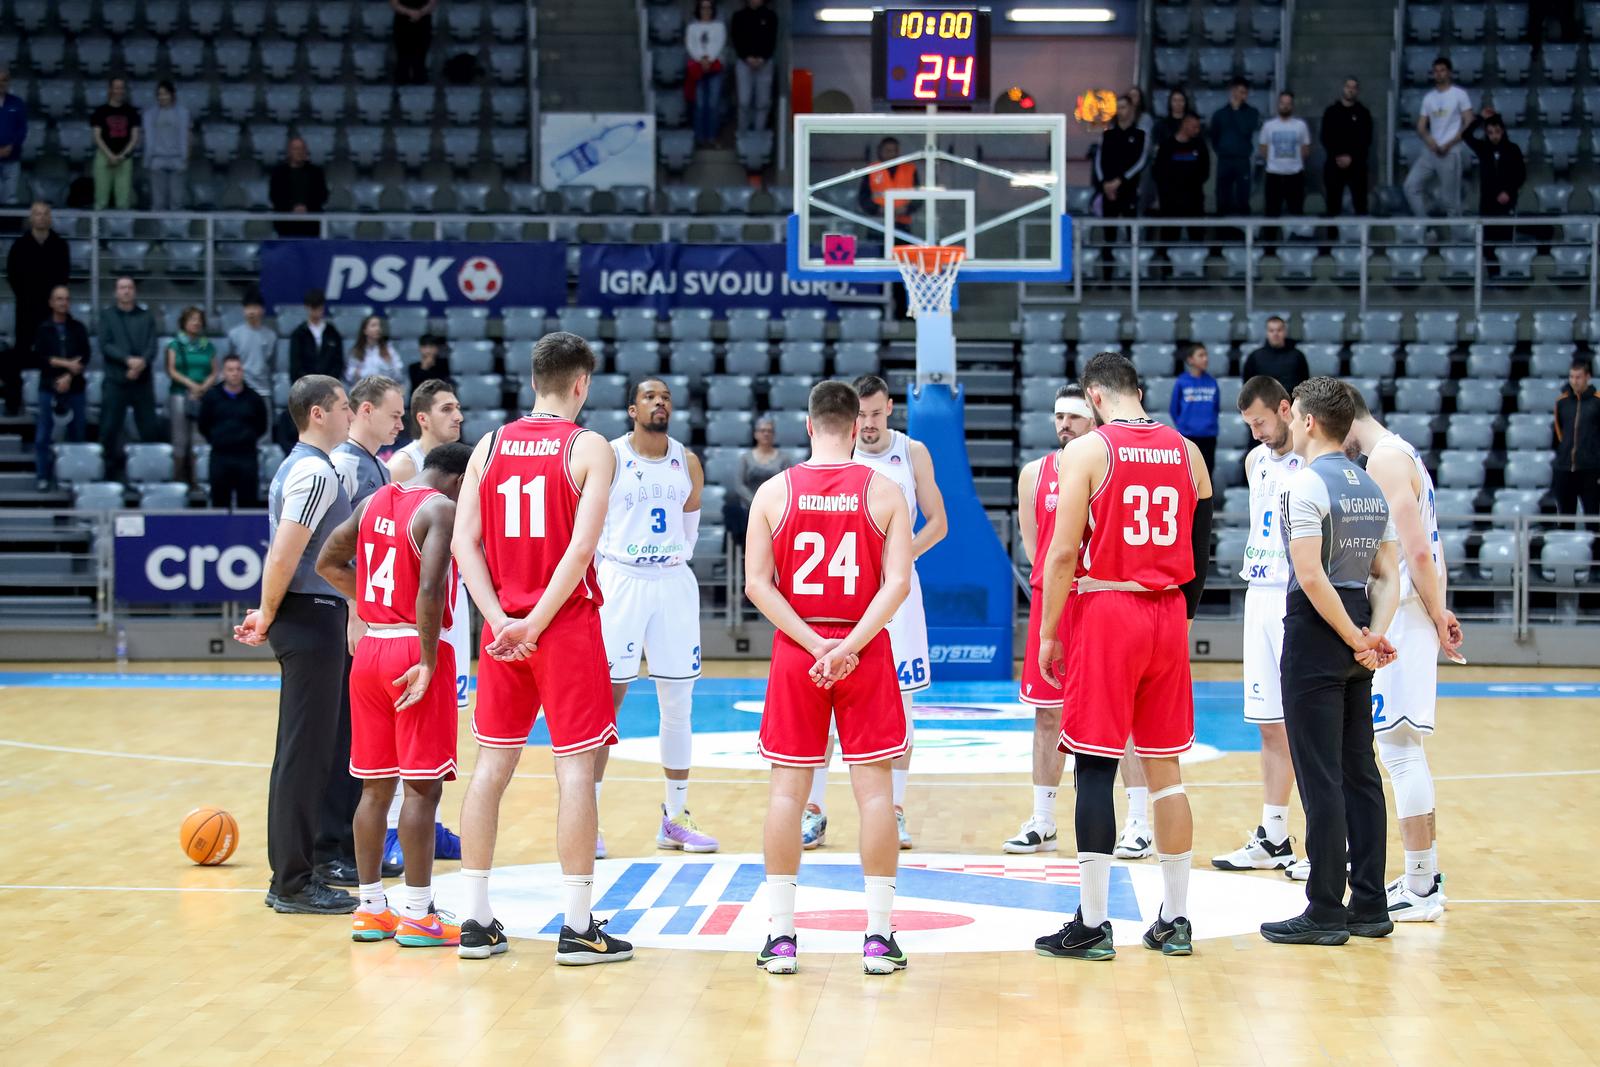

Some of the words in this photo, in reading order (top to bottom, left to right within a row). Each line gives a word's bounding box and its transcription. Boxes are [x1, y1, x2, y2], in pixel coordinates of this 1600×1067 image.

[900, 11, 973, 39] 10:00
[914, 54, 974, 98] 24
[325, 254, 456, 302] PSK
[599, 270, 677, 295] IGRAJ
[683, 271, 773, 296] SVOJU
[500, 438, 561, 457] KALAJŽIĆ
[1118, 446, 1182, 465] CVITKOVIĆ
[496, 475, 546, 538] 11
[798, 493, 859, 512] GIZDAVČIĆ
[1123, 484, 1179, 546] 33
[1351, 497, 1387, 514] GRAWE
[650, 507, 667, 534] 3
[1262, 510, 1273, 537] 9
[1339, 537, 1382, 550] VARTEKS
[792, 531, 860, 596] 24
[897, 657, 926, 685] 46
